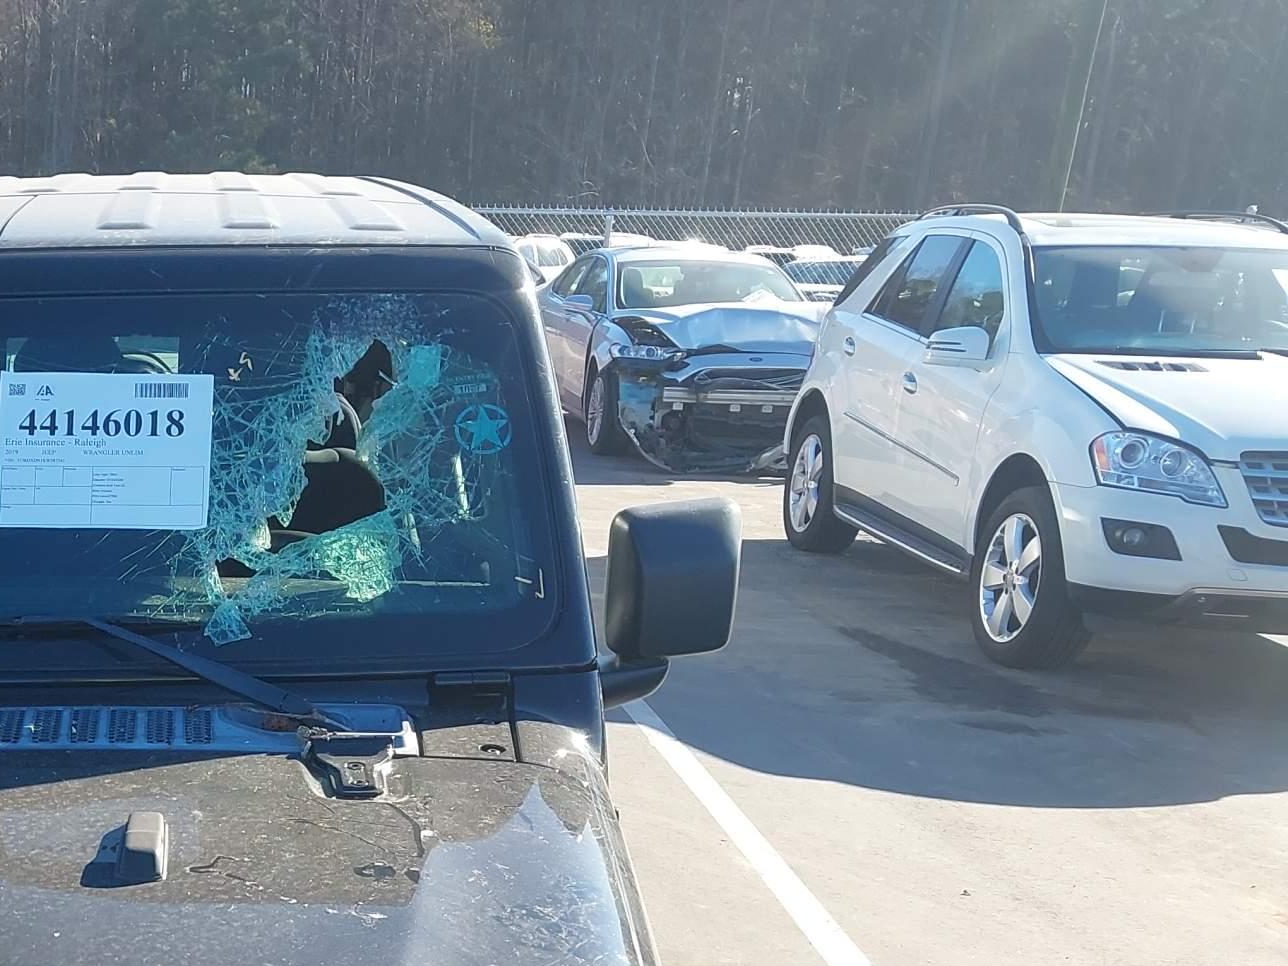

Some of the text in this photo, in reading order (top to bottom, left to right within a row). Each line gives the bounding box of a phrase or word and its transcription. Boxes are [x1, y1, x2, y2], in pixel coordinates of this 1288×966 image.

[18, 408, 186, 437] 44146018
[5, 437, 23, 447] Erie
[25, 437, 66, 447] Insurance
[74, 437, 107, 448] Raleigh
